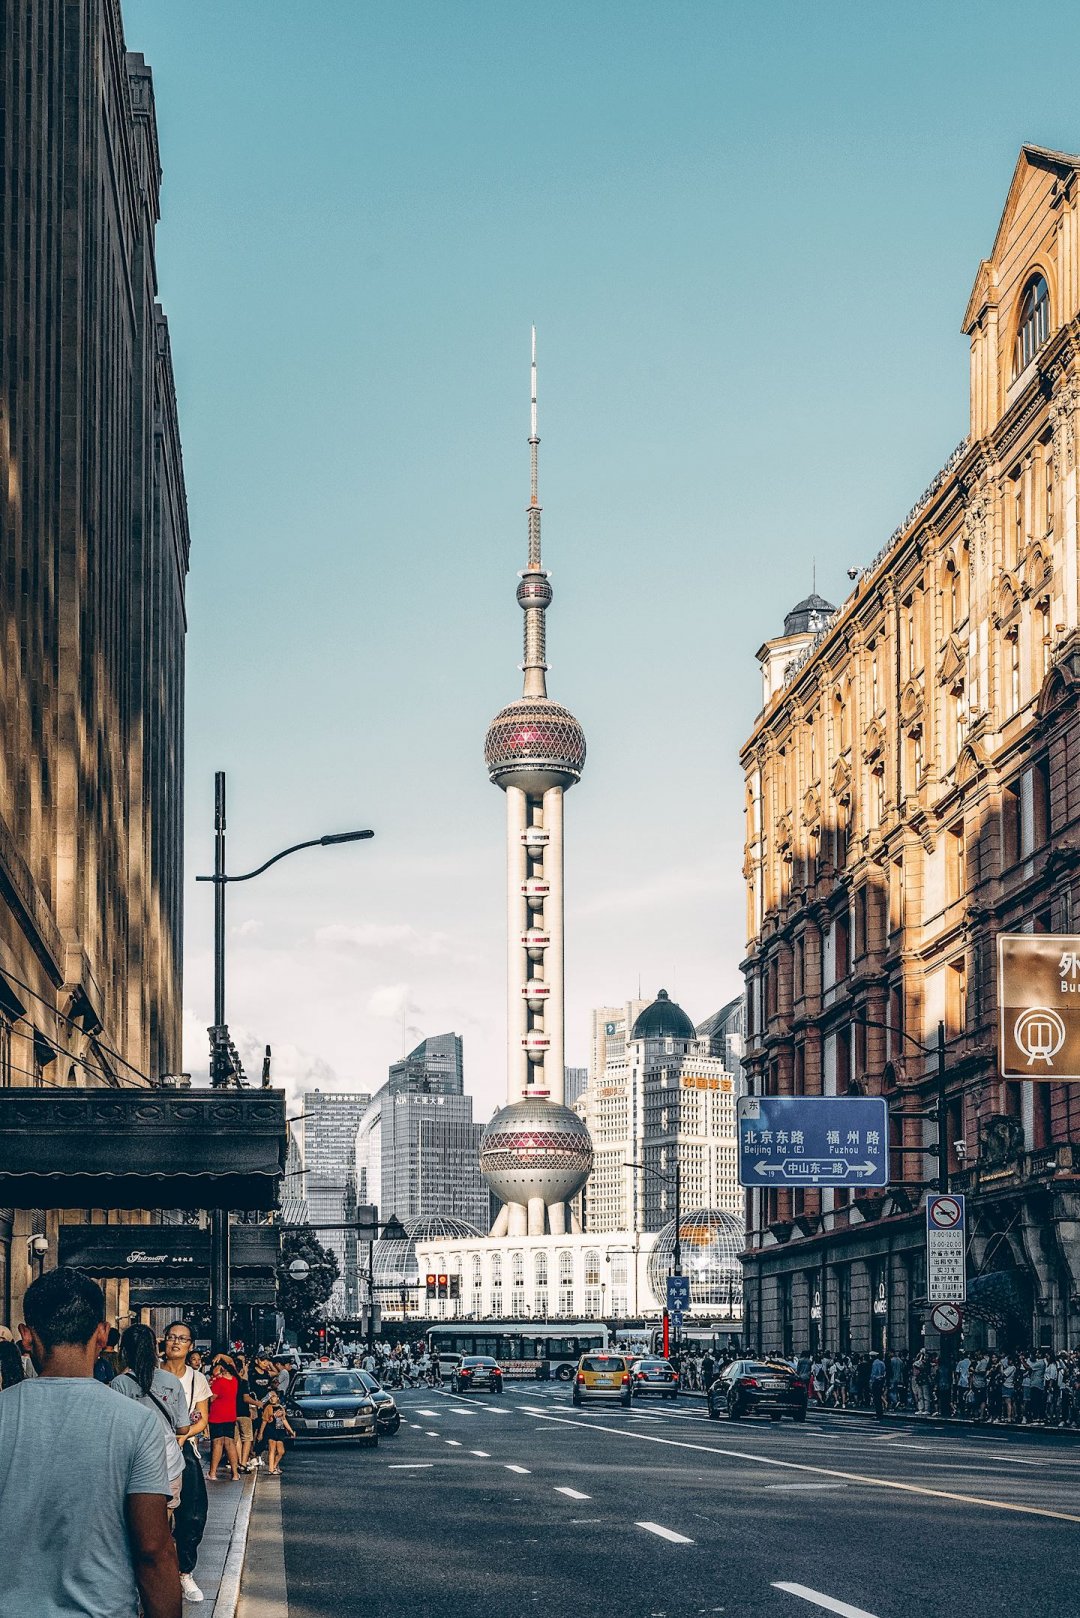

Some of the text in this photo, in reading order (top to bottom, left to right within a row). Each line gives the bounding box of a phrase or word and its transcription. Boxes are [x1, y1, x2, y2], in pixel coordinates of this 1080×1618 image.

[1061, 981, 1080, 993] Bu
[683, 1077, 732, 1091] 中国平安
[749, 1101, 758, 1110] 东
[744, 1130, 804, 1144] 北京东路
[744, 1146, 805, 1156] Beijing Rd. (E)
[829, 1146, 880, 1154] Fuzhou Rd.
[788, 1162, 843, 1174] 中山东一路
[126, 1251, 168, 1263] Fairmont
